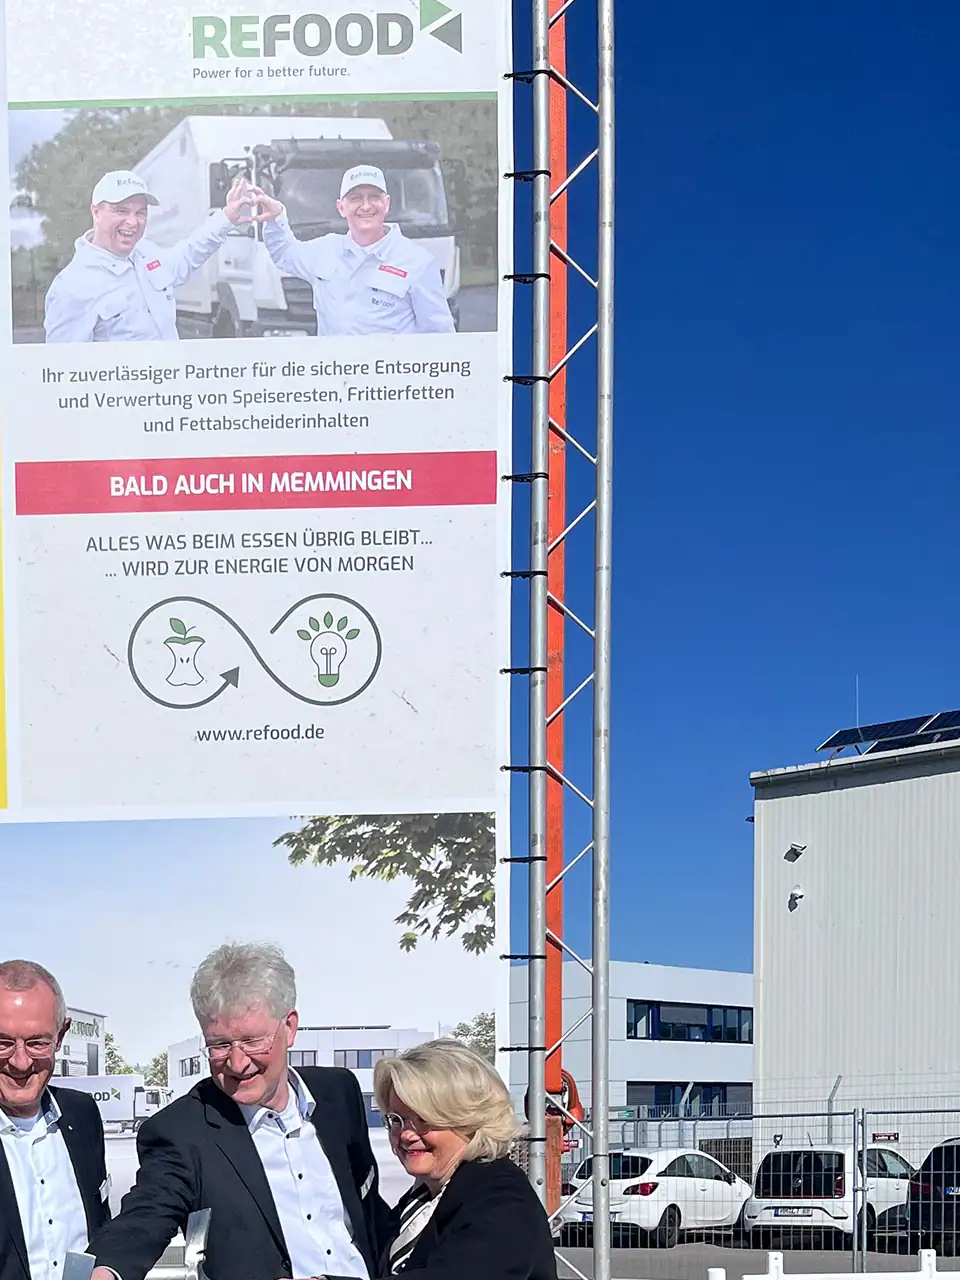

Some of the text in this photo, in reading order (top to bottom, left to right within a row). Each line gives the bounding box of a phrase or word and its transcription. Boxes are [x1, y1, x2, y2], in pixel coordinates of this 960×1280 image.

[193, 12, 413, 59] REFOOD
[193, 65, 350, 80] Power for a better future.
[41, 359, 471, 386] Ihr zuverlässiger Partner für die sichere Entsorgung
[58, 385, 455, 411] und Verwertung von Speiseresten, Frittierfetten
[143, 413, 369, 432] und Fettabscheiderinhalten
[110, 470, 413, 497] BALD AUCH IN MEMMINGEN
[85, 528, 433, 552] ALLES WAS BEIM ESSEN ÜBRIG BLEIBT...
[122, 561, 169, 577] WIRD
[174, 560, 209, 575] ZUR
[214, 558, 288, 575] ENERGIE
[294, 557, 332, 573] VON
[337, 556, 414, 572] MORGEN
[196, 724, 325, 741] www.refood.de
